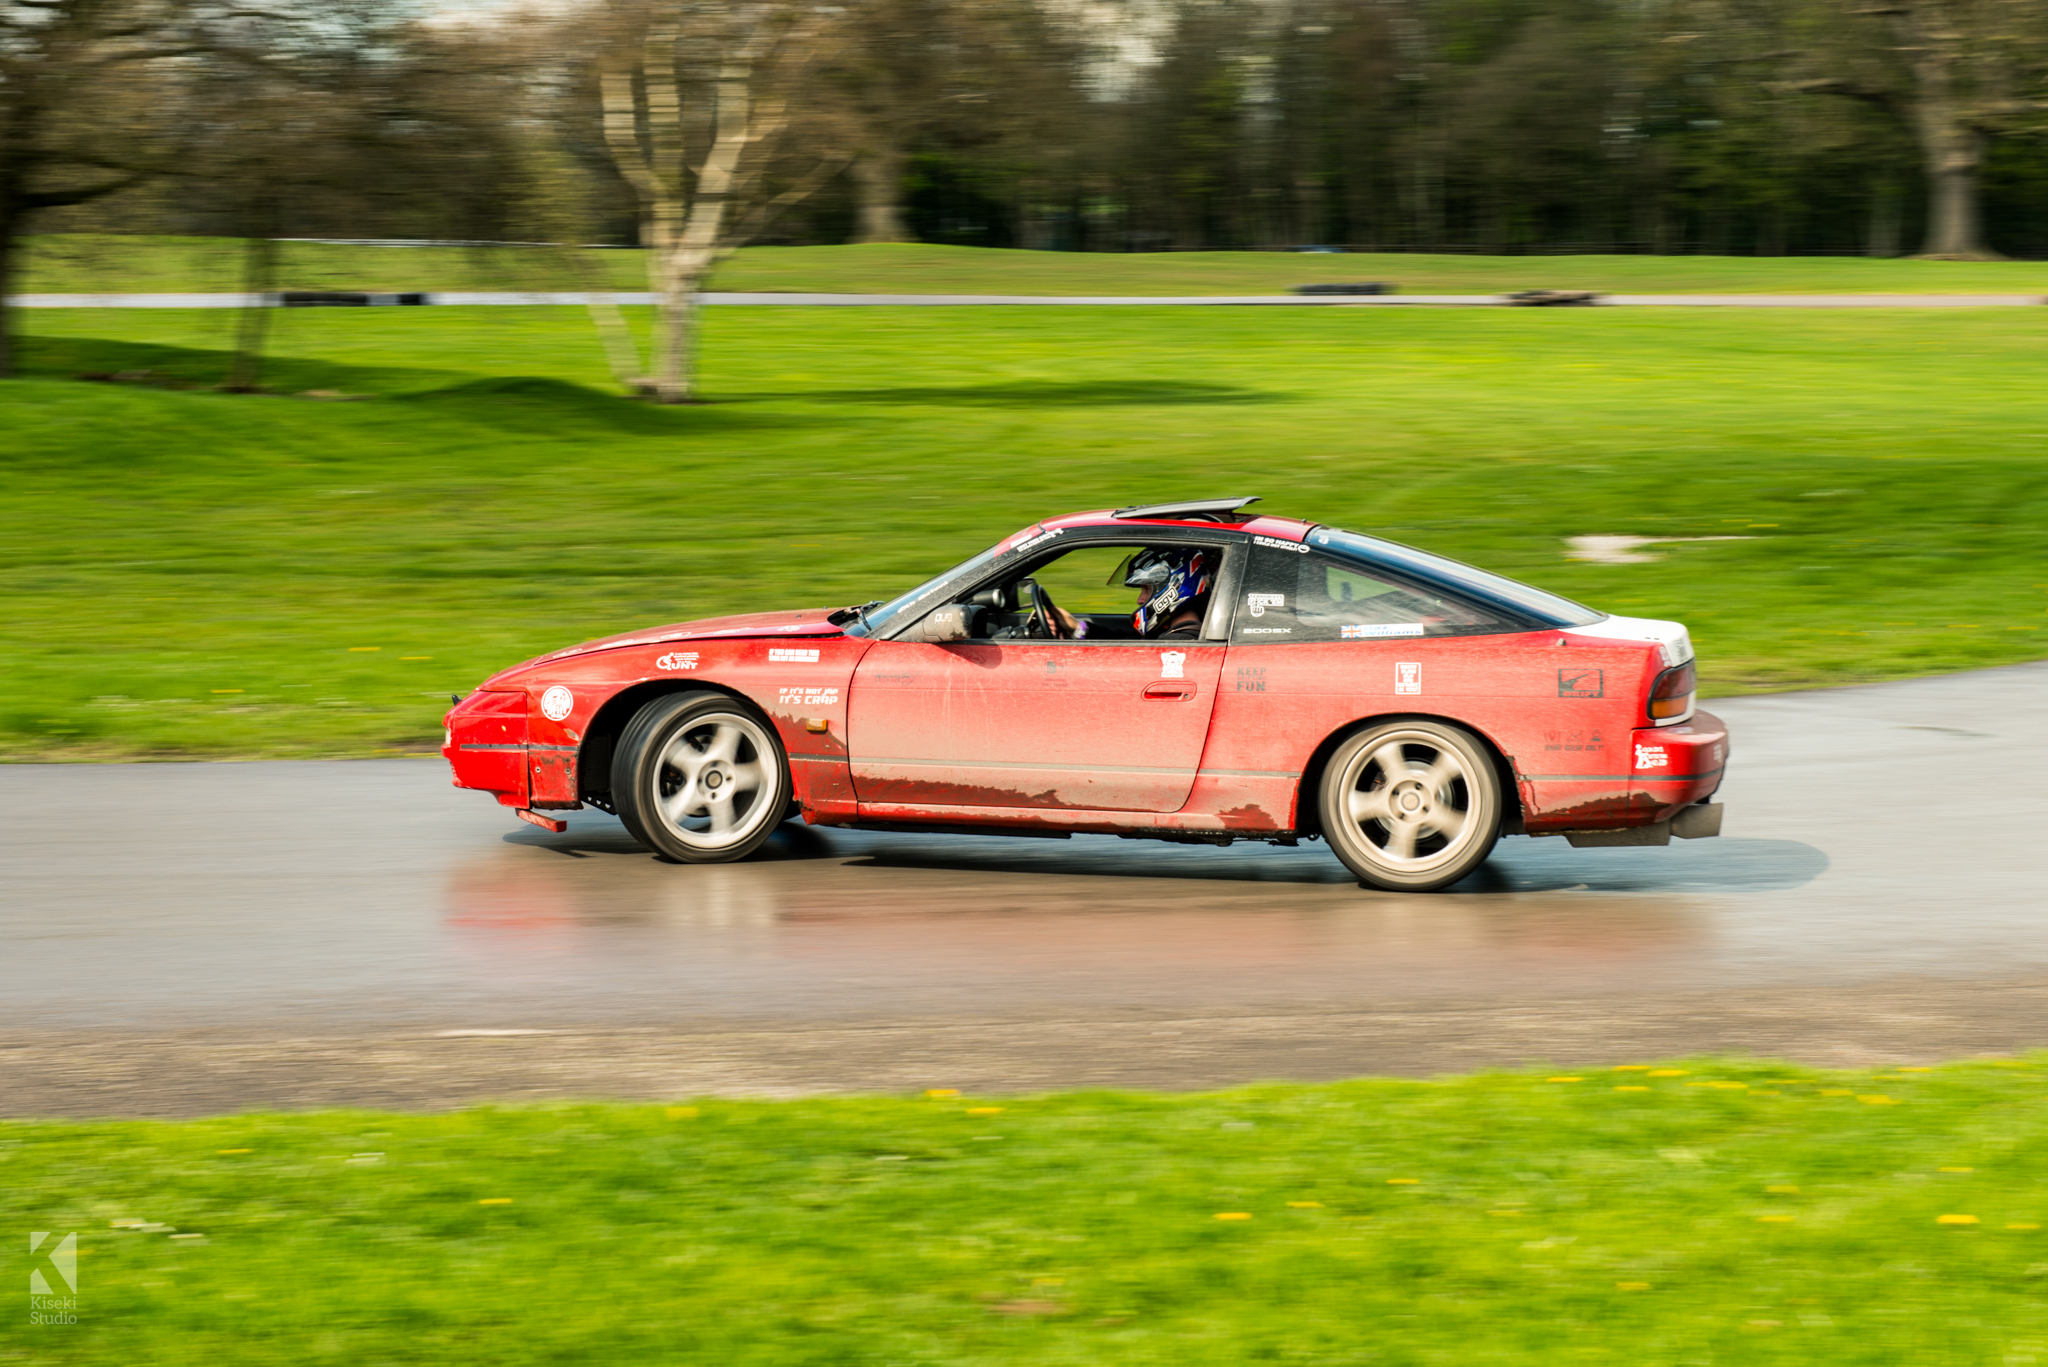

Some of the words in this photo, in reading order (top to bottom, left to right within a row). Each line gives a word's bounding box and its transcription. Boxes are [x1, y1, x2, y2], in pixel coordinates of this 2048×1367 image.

[1275, 539, 1300, 548] HAPPY
[1156, 588, 1175, 611] agv
[808, 649, 820, 657] THIS
[1237, 667, 1266, 676] KEEP
[1237, 681, 1265, 691] FUN
[779, 687, 788, 695] IF
[789, 687, 804, 695] IT'S
[805, 687, 822, 695] NOT
[821, 687, 839, 697] JAP
[779, 694, 802, 704] IT'S
[804, 695, 839, 705] CRAP
